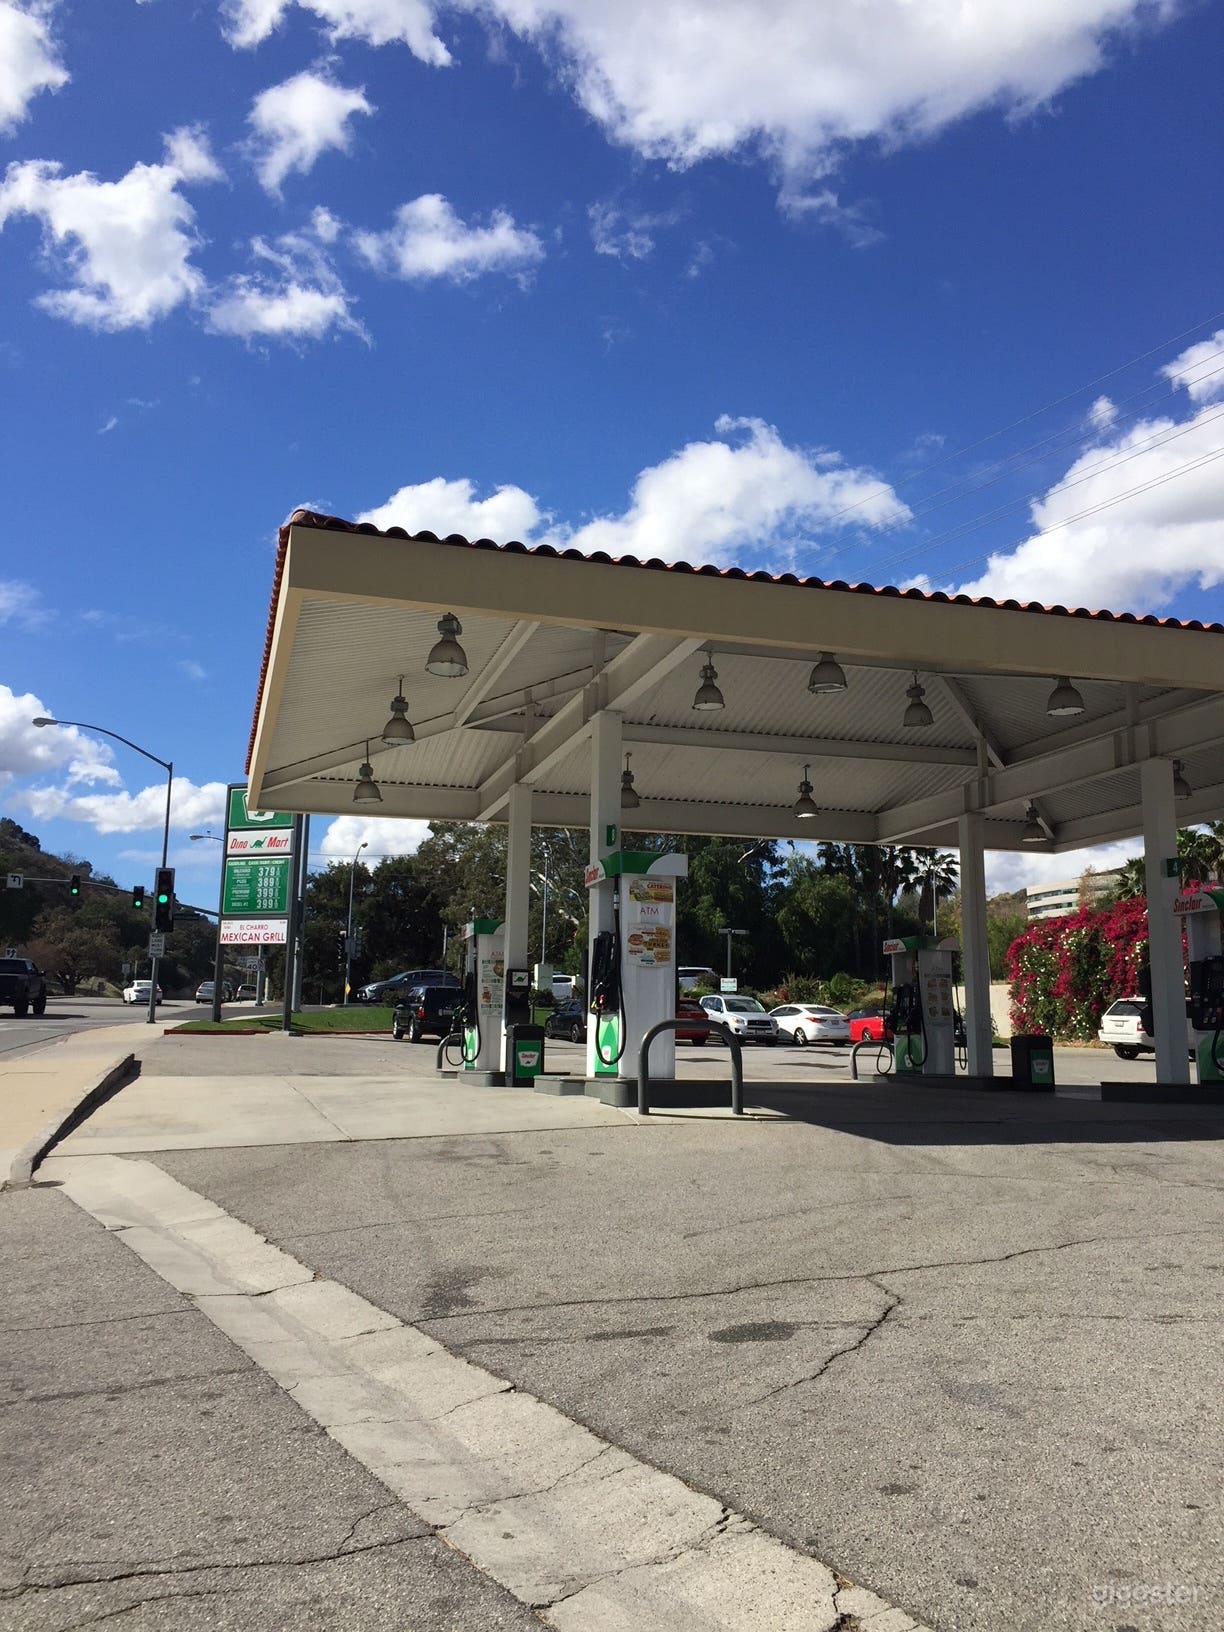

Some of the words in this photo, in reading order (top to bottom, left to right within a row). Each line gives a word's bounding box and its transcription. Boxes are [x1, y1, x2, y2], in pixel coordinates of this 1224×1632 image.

[230, 838, 248, 849] Dino
[267, 836, 289, 848] Mart
[258, 866, 276, 877] 379
[257, 877, 275, 887] 389
[257, 888, 274, 898] 399
[256, 898, 274, 909] 399
[1173, 897, 1203, 913] Sinclair
[640, 906, 660, 916] ATM
[221, 932, 261, 942] MEXICAN
[263, 932, 285, 942] GRILL
